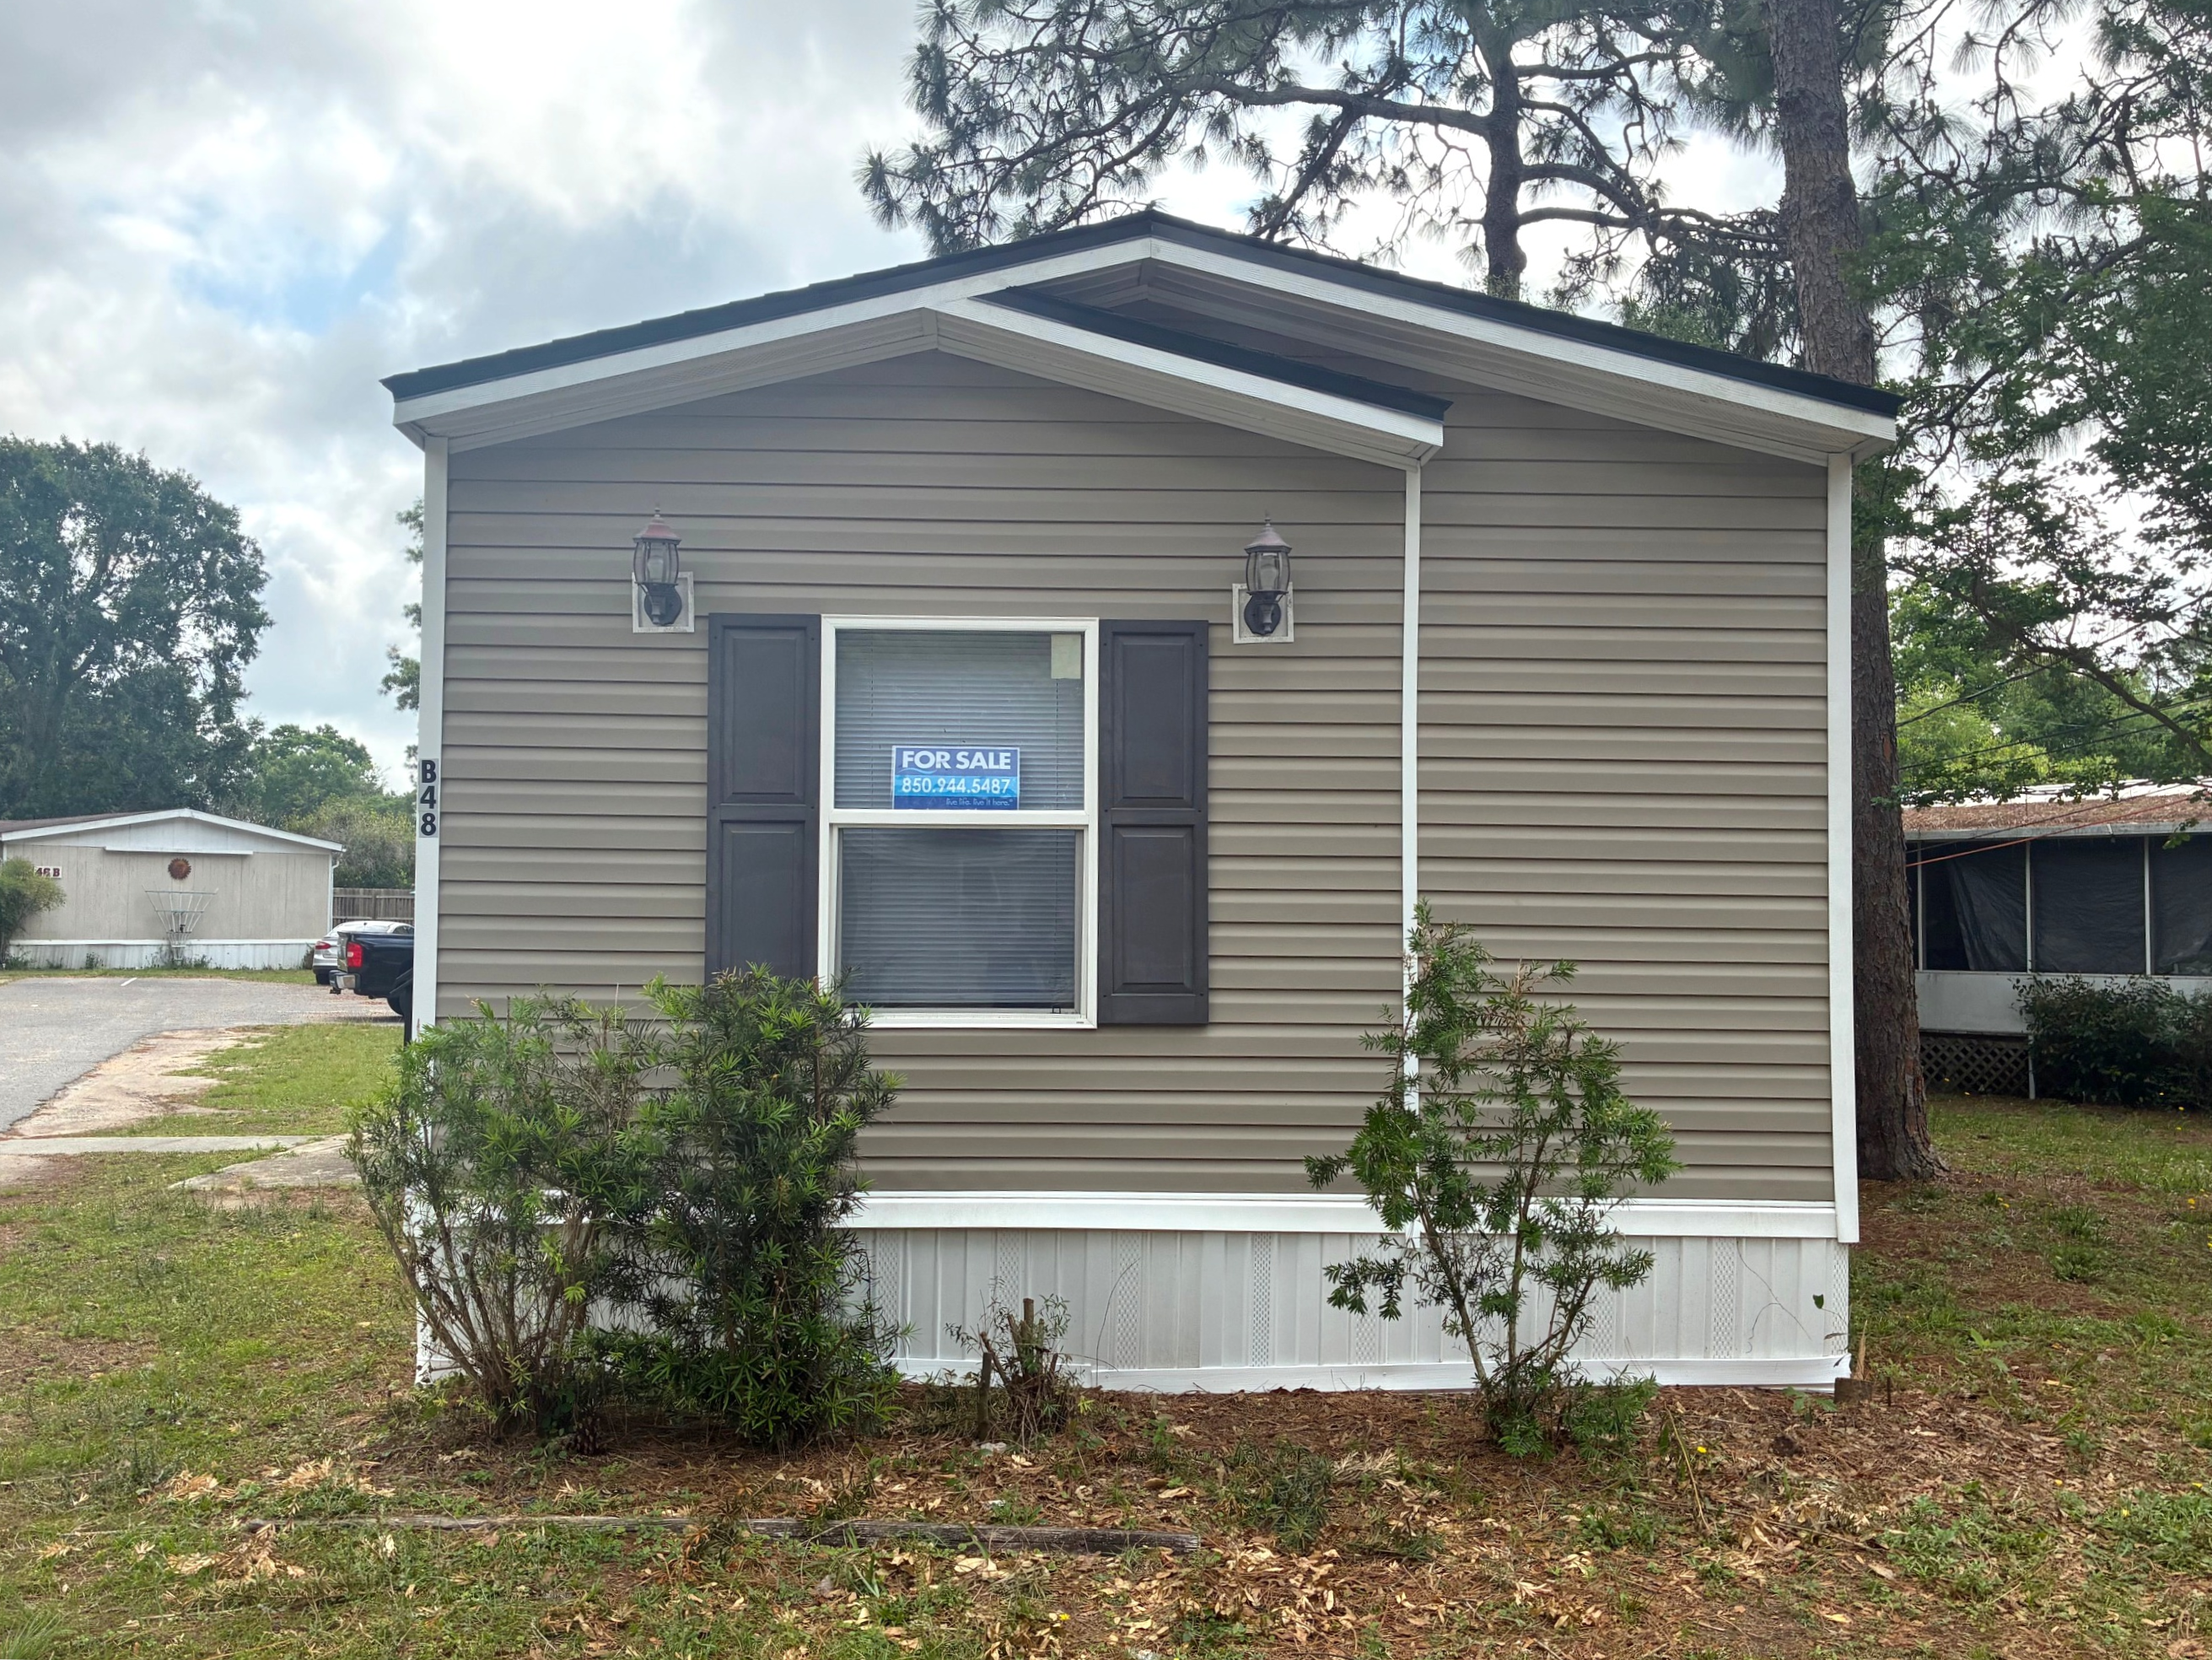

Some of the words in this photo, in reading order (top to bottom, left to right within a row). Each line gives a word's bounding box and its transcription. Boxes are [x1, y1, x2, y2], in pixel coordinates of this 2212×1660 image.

[902, 751, 952, 768] FOR
[955, 752, 1011, 769] SALE
[901, 778, 1010, 794] 850.944.5487
[420, 759, 437, 836] B48
[945, 797, 958, 806] live
[972, 797, 985, 806] live
[53, 867, 60, 877] B
